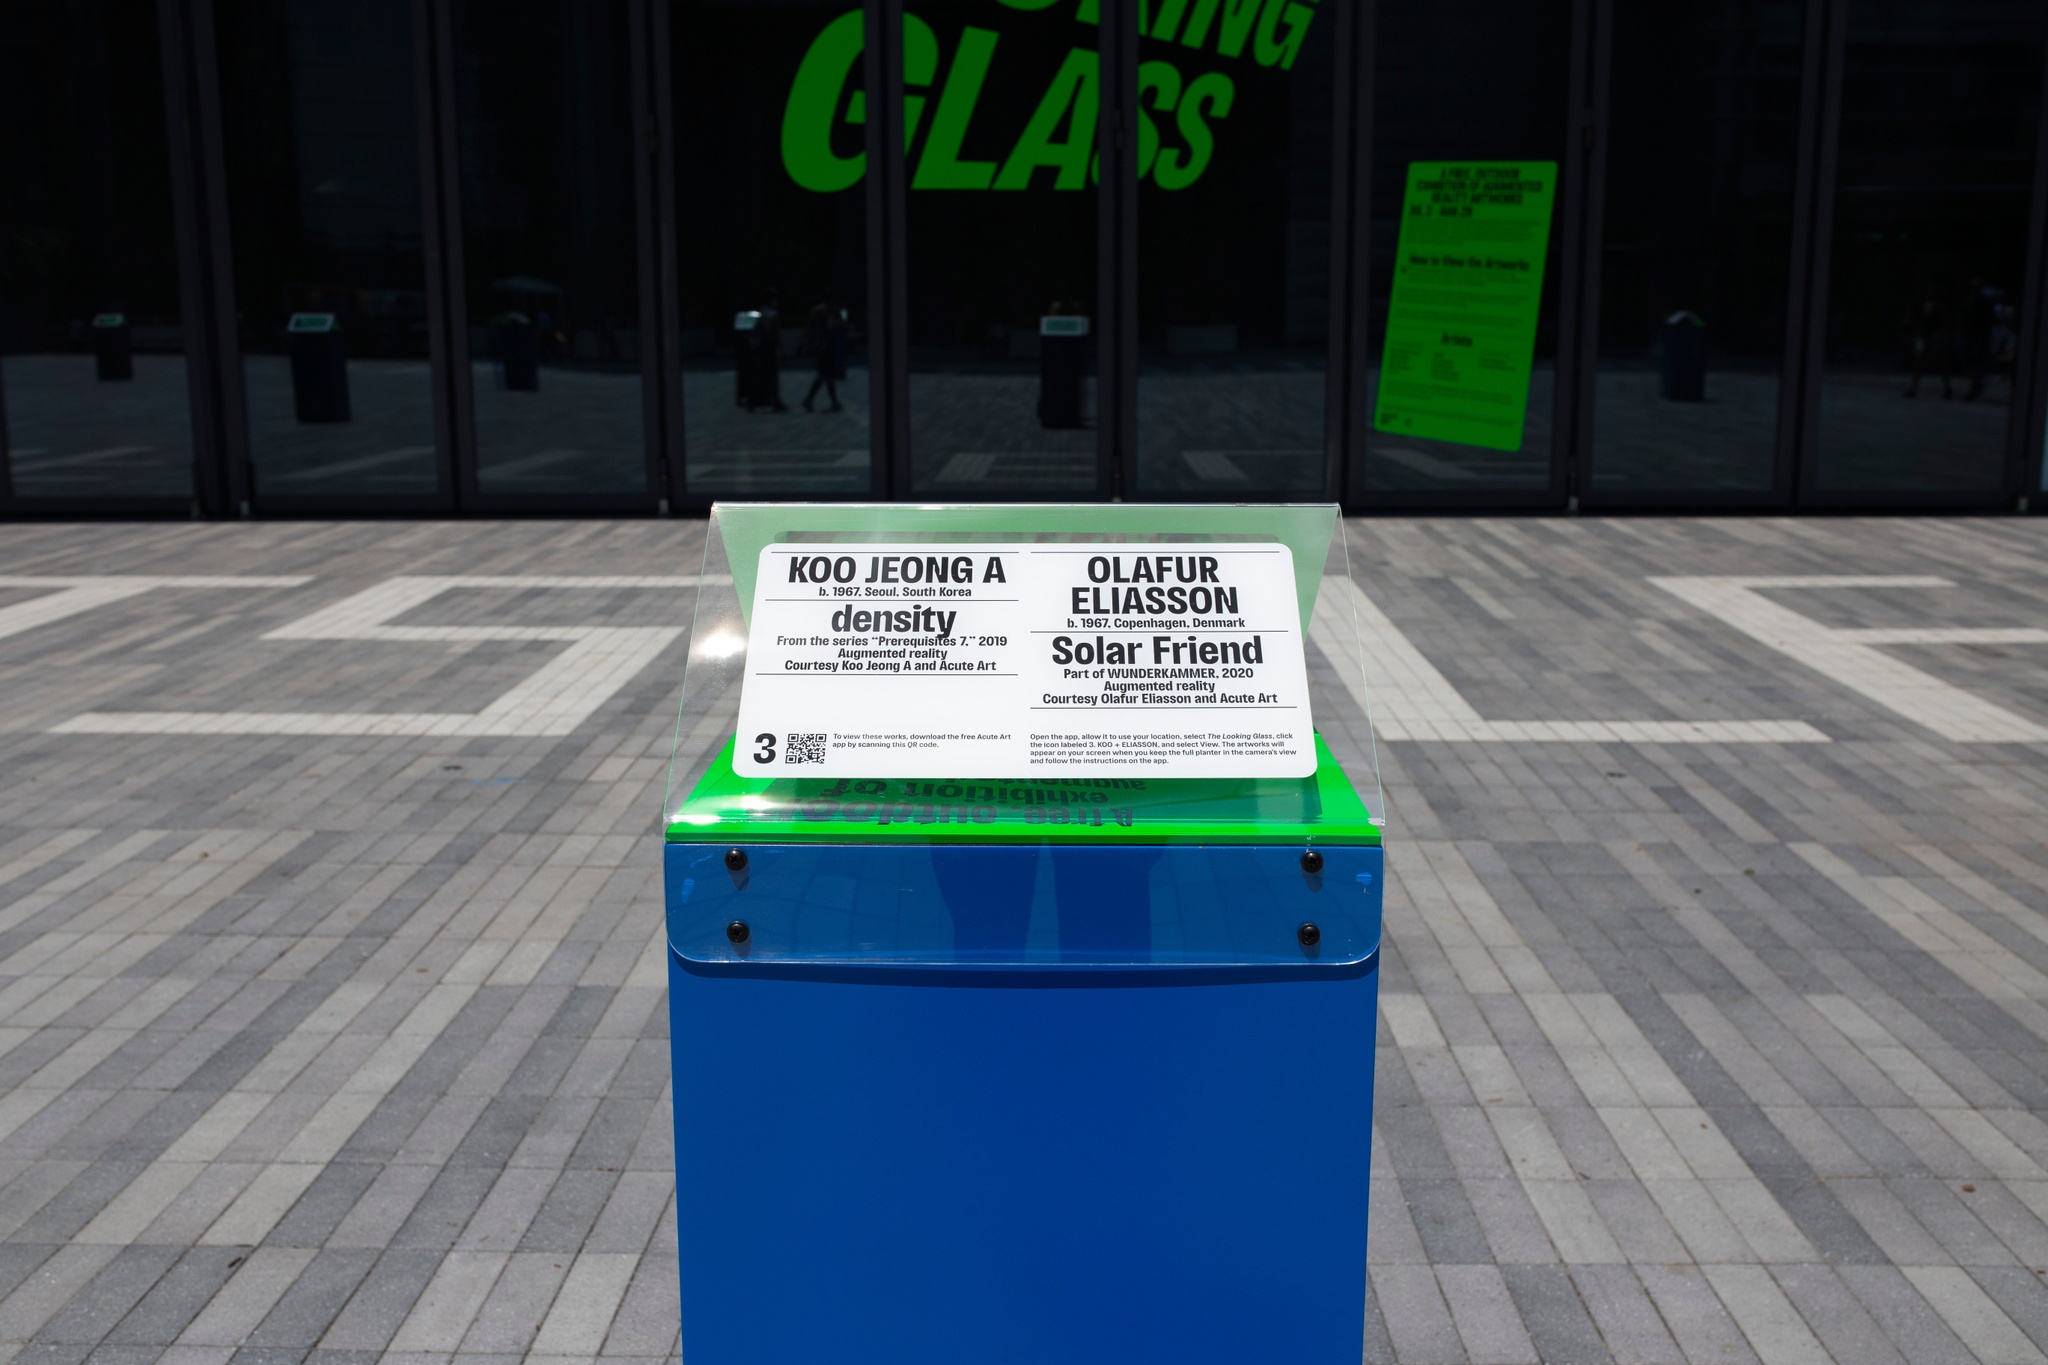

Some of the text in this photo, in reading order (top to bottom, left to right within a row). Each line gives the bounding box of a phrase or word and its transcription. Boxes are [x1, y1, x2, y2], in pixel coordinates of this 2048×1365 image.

[780, 9, 1236, 193] GLASS
[788, 556, 1006, 583] KOO JEONG A
[1088, 556, 1220, 583] OLAFUR
[819, 587, 971, 596] b. 1967, Seoul, South Korea
[1072, 586, 1238, 614] ELIASSON
[832, 604, 957, 638] density
[1068, 618, 1245, 630] b. 1967, Copenhagen, Denmark
[777, 636, 806, 645] From
[810, 636, 829, 646] the
[833, 636, 868, 646] series
[979, 636, 1007, 646] 2019
[1052, 635, 1263, 665] Solar Friend
[838, 647, 948, 660] Augmented reality
[785, 659, 996, 672] Courtesy Koo Jeong A and Acute Art
[1064, 668, 1253, 678] Part of WUNDERKAMMER, 2020
[1104, 680, 1215, 692] Augmented reality
[1043, 692, 1278, 705] Courtesy Olafur Eliasson and Acute Art
[754, 733, 776, 764] 3
[819, 778, 1108, 805] exhibition of
[1110, 808, 1133, 827] A
